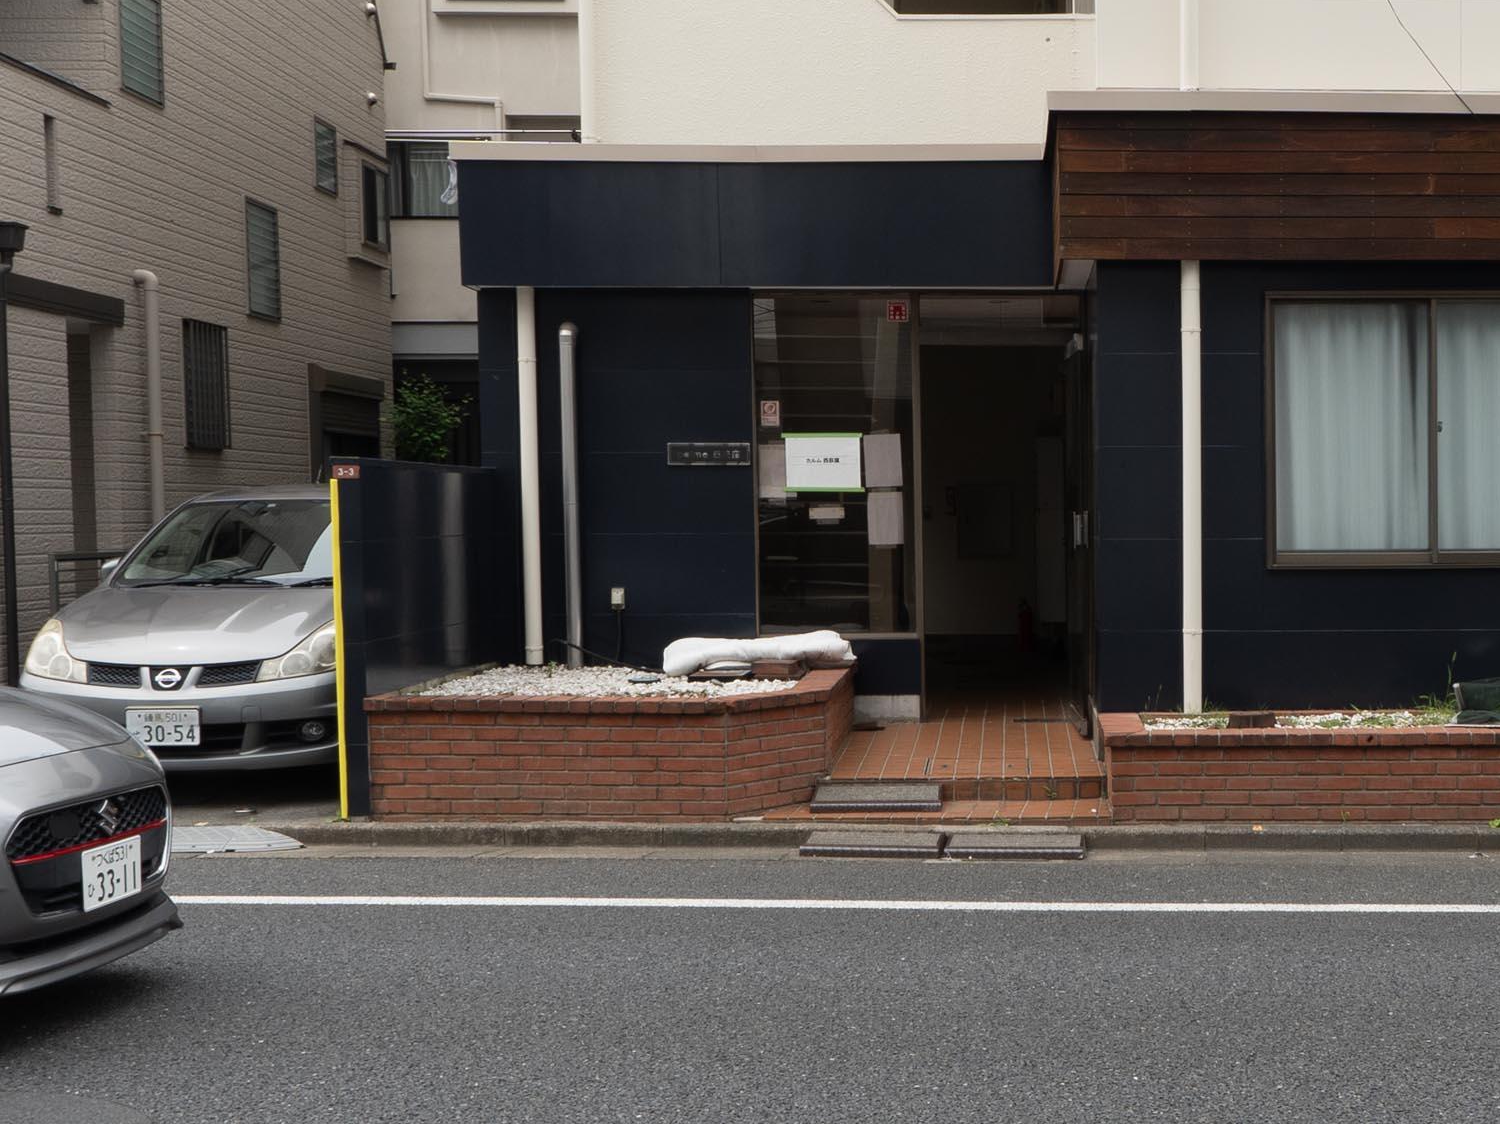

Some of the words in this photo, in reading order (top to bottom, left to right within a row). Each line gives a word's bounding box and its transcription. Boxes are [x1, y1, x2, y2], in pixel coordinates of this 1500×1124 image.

[337, 467, 354, 476] 3-3
[143, 724, 196, 743] 30-54
[96, 861, 136, 902] 33-11
